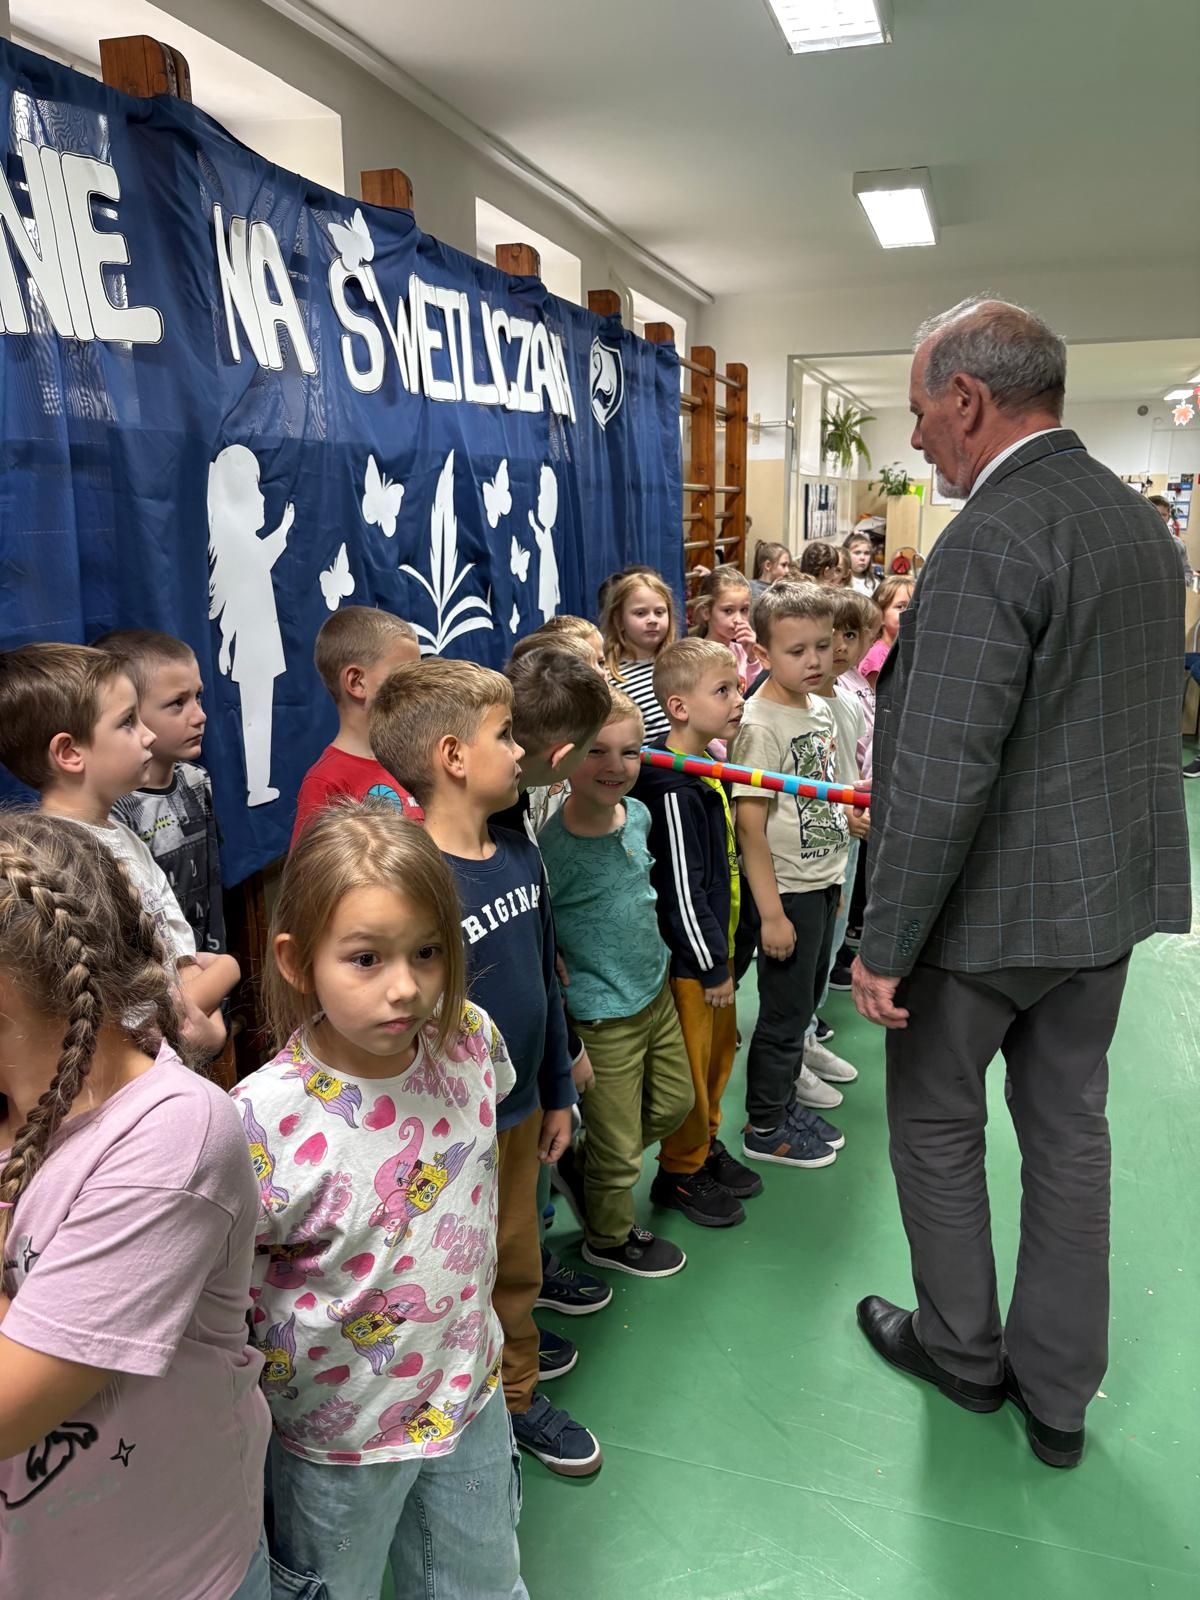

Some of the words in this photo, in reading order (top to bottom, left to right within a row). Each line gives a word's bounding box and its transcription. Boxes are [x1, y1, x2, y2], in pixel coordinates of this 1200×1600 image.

[0, 138, 163, 343] NIE
[213, 202, 318, 375] NA
[801, 848, 830, 860] WILD
[460, 883, 540, 945] RIGINA
